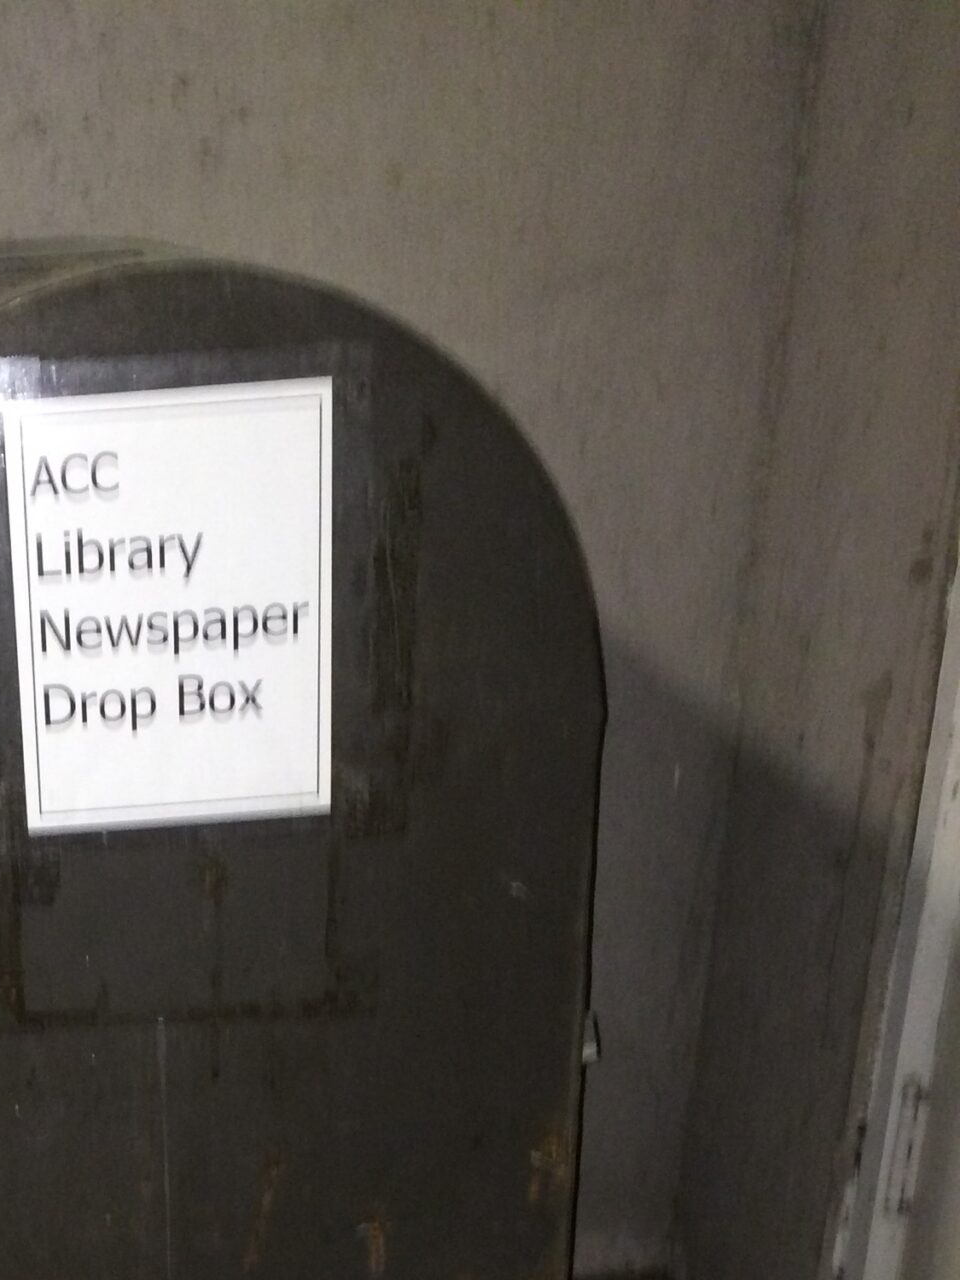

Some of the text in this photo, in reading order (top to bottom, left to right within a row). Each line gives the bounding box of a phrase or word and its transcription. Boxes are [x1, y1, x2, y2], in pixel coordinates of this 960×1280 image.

[30, 452, 120, 497] ACC
[36, 529, 203, 580] Library
[39, 601, 310, 656] Newspaper
[43, 675, 263, 733] Drop Box
